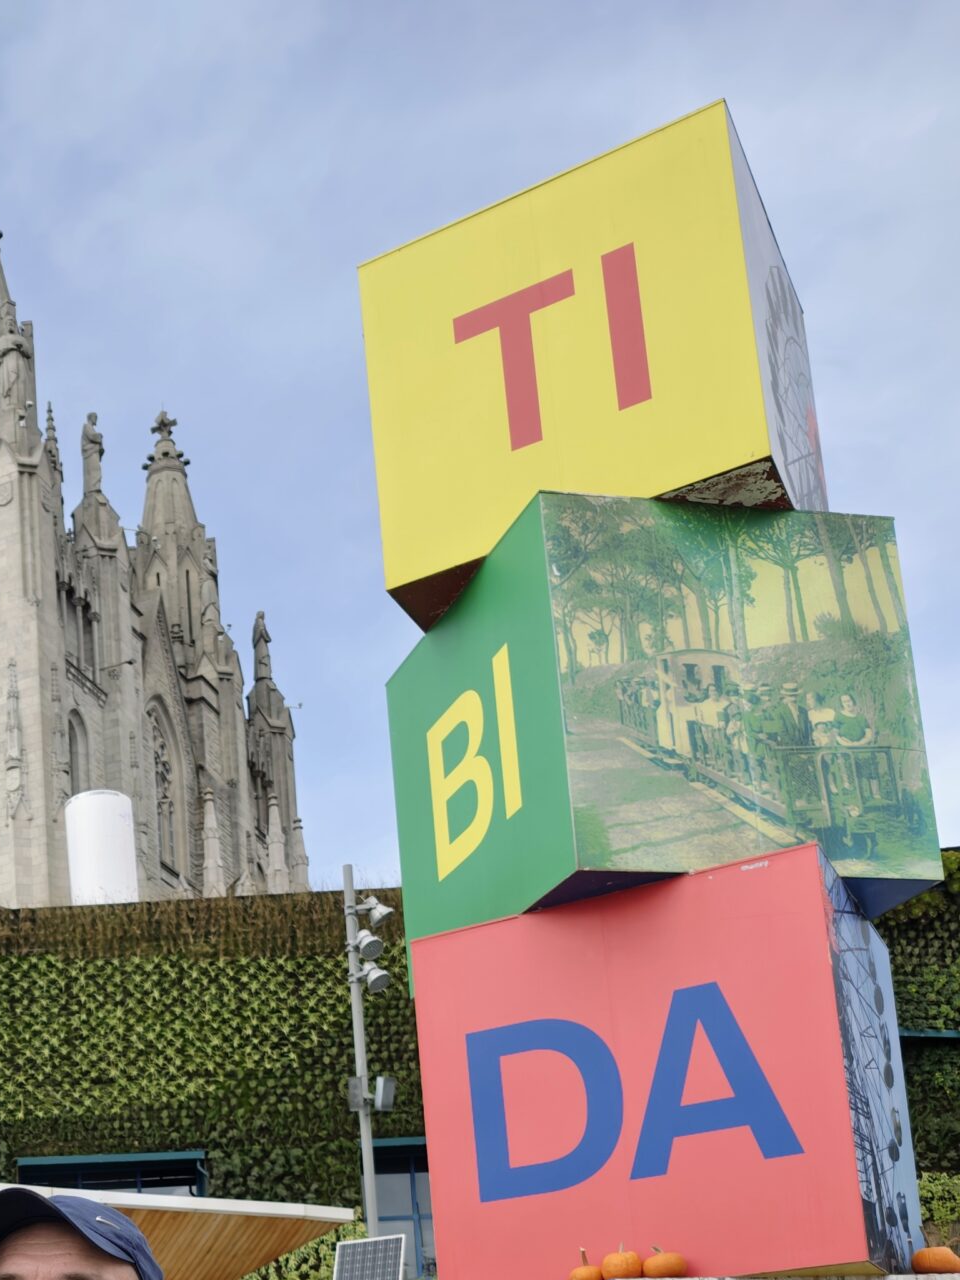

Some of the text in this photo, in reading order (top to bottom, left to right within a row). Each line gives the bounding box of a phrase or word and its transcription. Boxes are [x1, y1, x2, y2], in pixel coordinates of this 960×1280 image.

[452, 242, 652, 451] TI
[426, 643, 522, 882] BI
[465, 982, 804, 1203] DA
